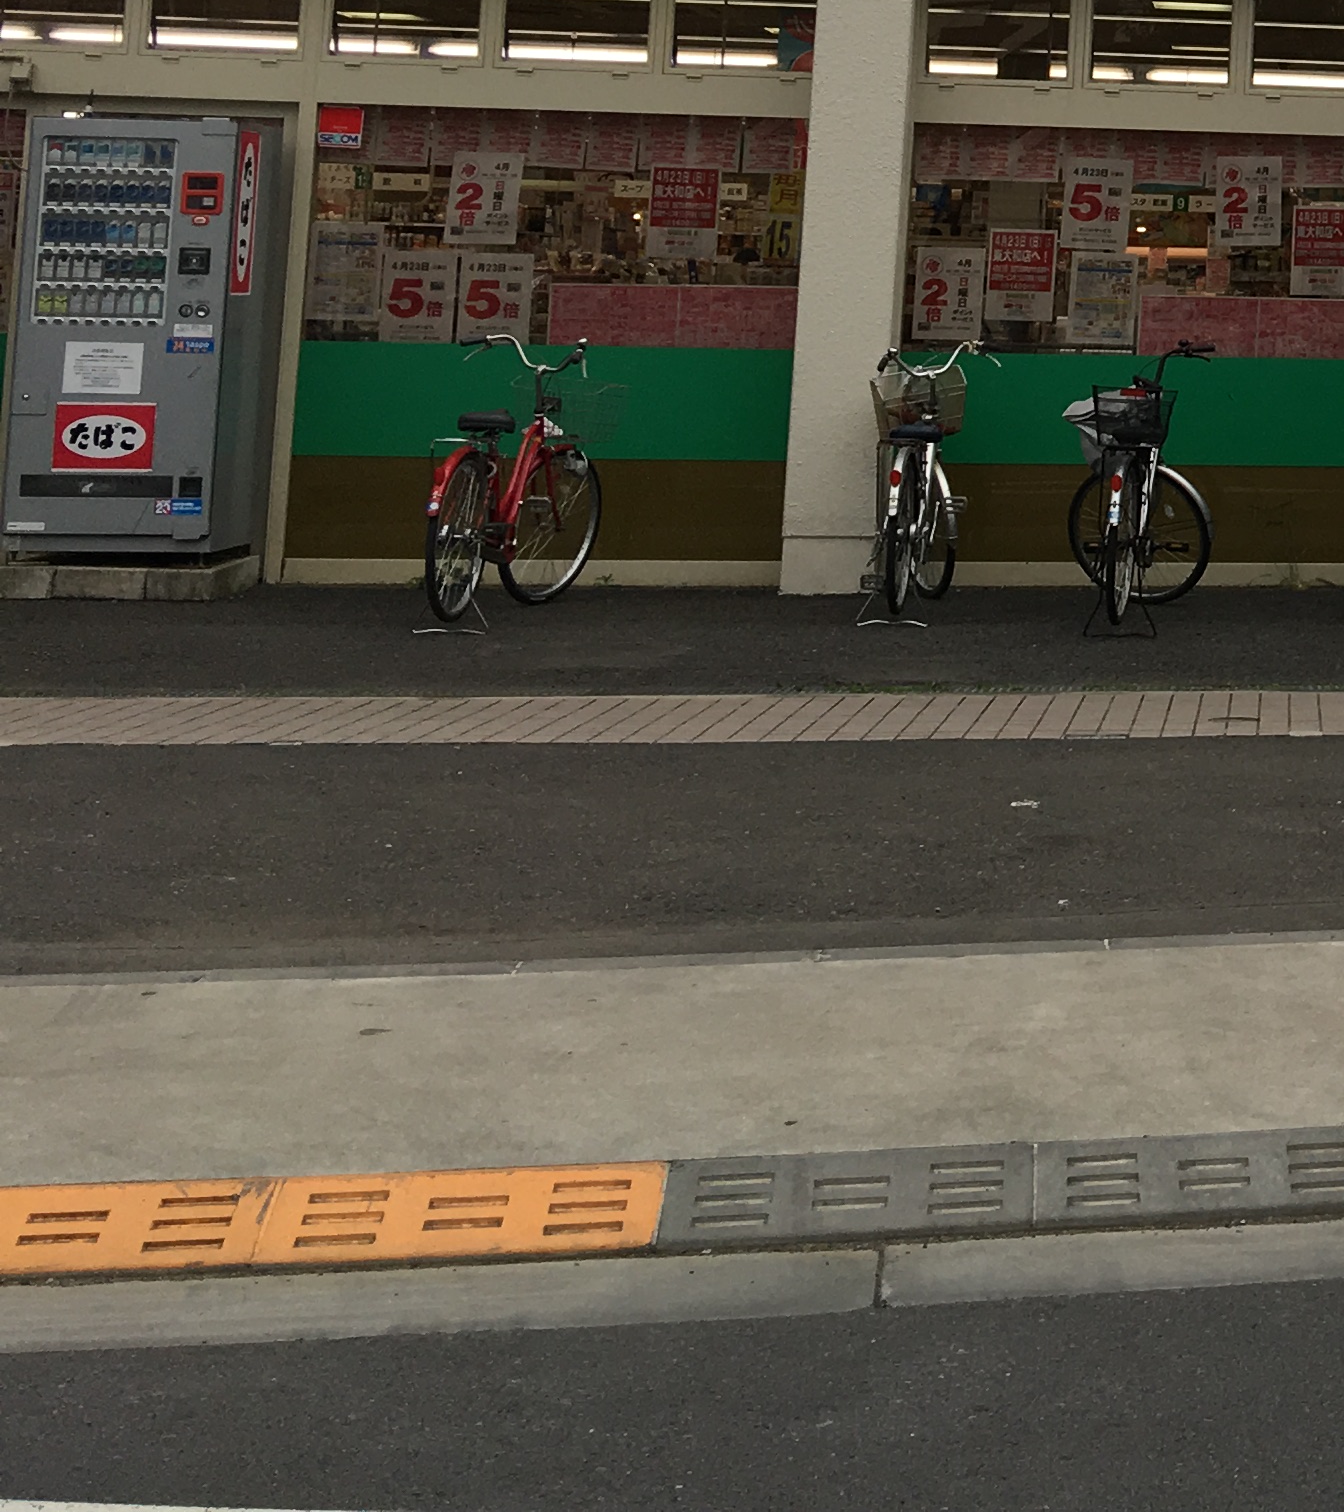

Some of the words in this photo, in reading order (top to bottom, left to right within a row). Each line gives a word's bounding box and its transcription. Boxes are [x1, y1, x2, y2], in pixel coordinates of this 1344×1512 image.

[320, 134, 358, 144] SECOM
[69, 422, 137, 450] たばこ
